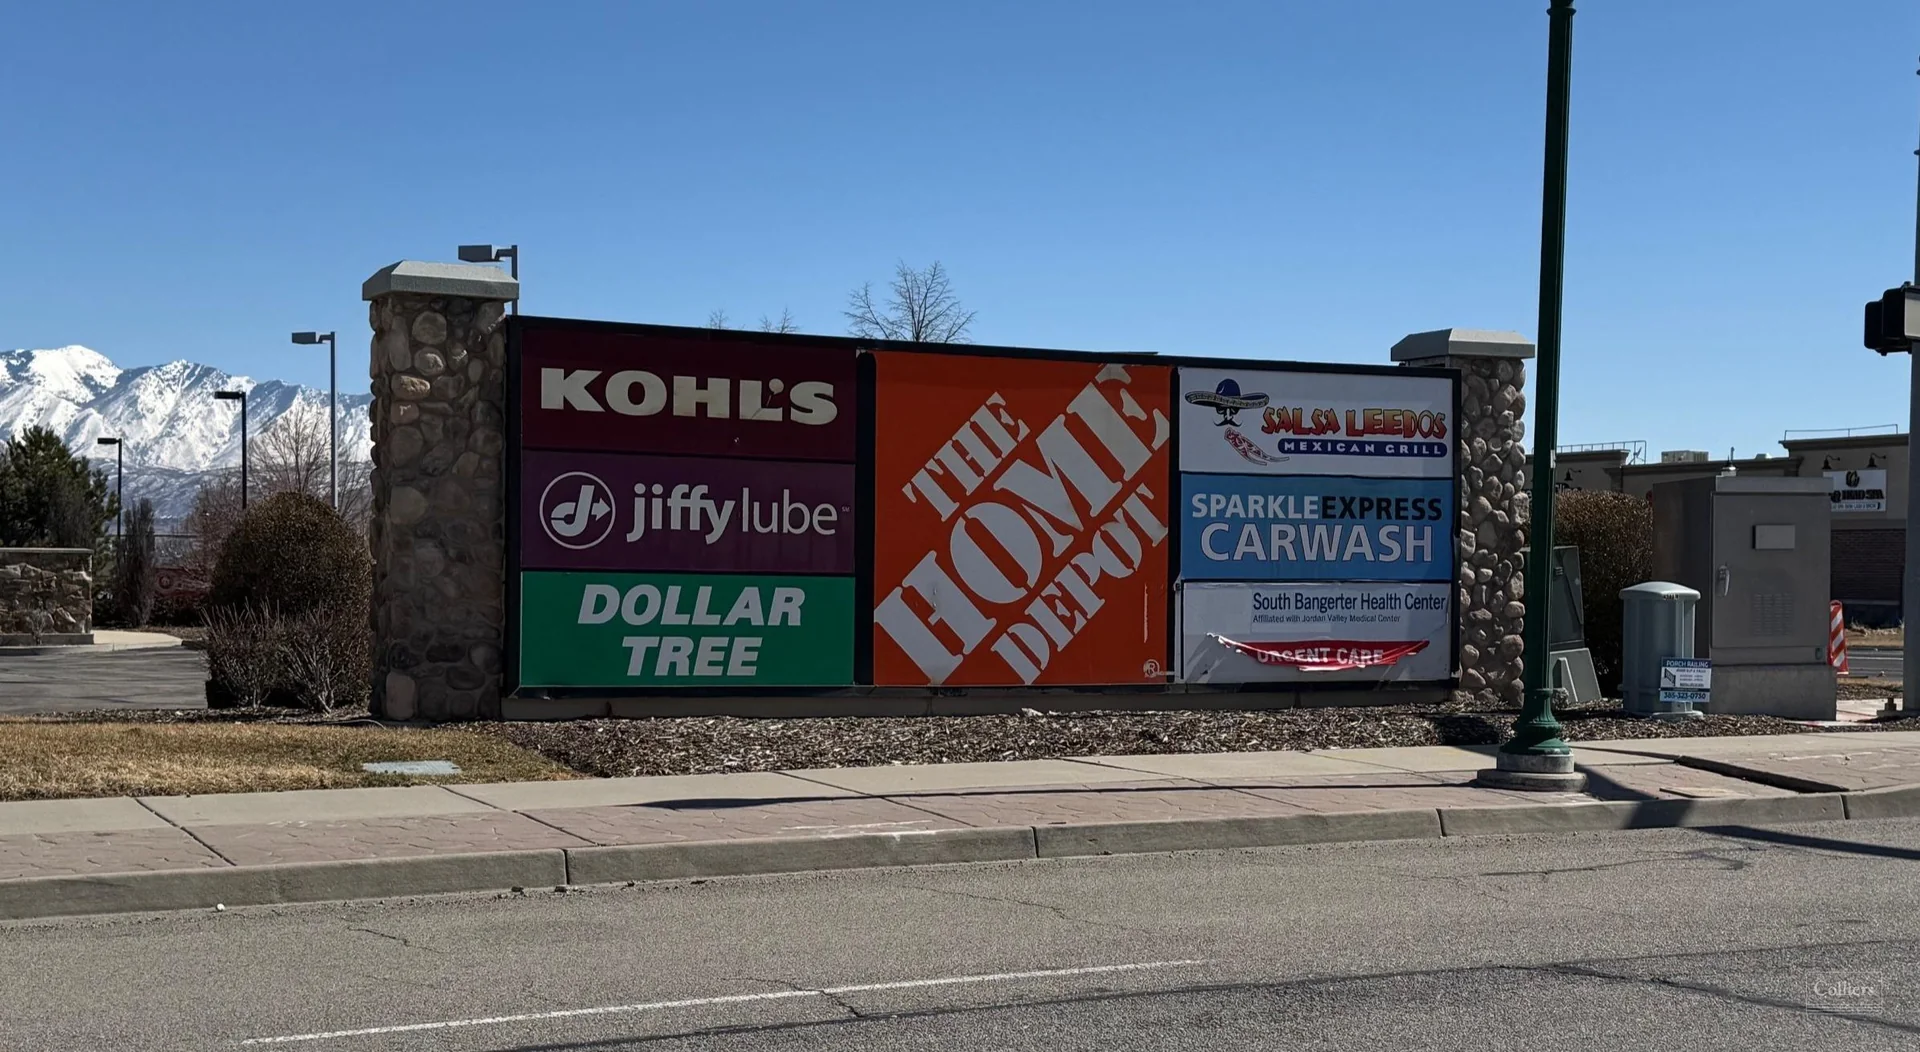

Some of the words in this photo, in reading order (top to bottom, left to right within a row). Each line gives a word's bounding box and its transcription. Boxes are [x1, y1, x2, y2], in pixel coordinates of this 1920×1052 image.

[540, 367, 838, 426] KOHL'S
[1261, 406, 1341, 436] SALSA
[1345, 408, 1448, 440] LEEDOS
[902, 391, 1031, 523] THE
[1284, 441, 1375, 453] MEXICAN
[1385, 444, 1441, 455] GRILL
[873, 363, 1170, 687] HOME
[1200, 522, 1433, 562] CARWASH
[990, 482, 1168, 686] DEPOT
[1253, 592, 1291, 610] South
[1295, 593, 1357, 614] Bangerter
[1361, 593, 1402, 610] Health
[1404, 593, 1446, 611] Center
[577, 584, 806, 626] DOLLAR
[1253, 614, 1284, 623] Affiliated
[1285, 614, 1300, 623] with
[1302, 614, 1326, 623] Jordan
[1328, 614, 1348, 624] Valley
[1349, 614, 1376, 623] Medical
[1378, 614, 1401, 623] Center
[621, 636, 763, 677] TREE
[1257, 647, 1331, 664] URGENT
[1336, 647, 1384, 665] CARE
[1666, 659, 1686, 667] PORCH
[1687, 660, 1709, 668] RAILING
